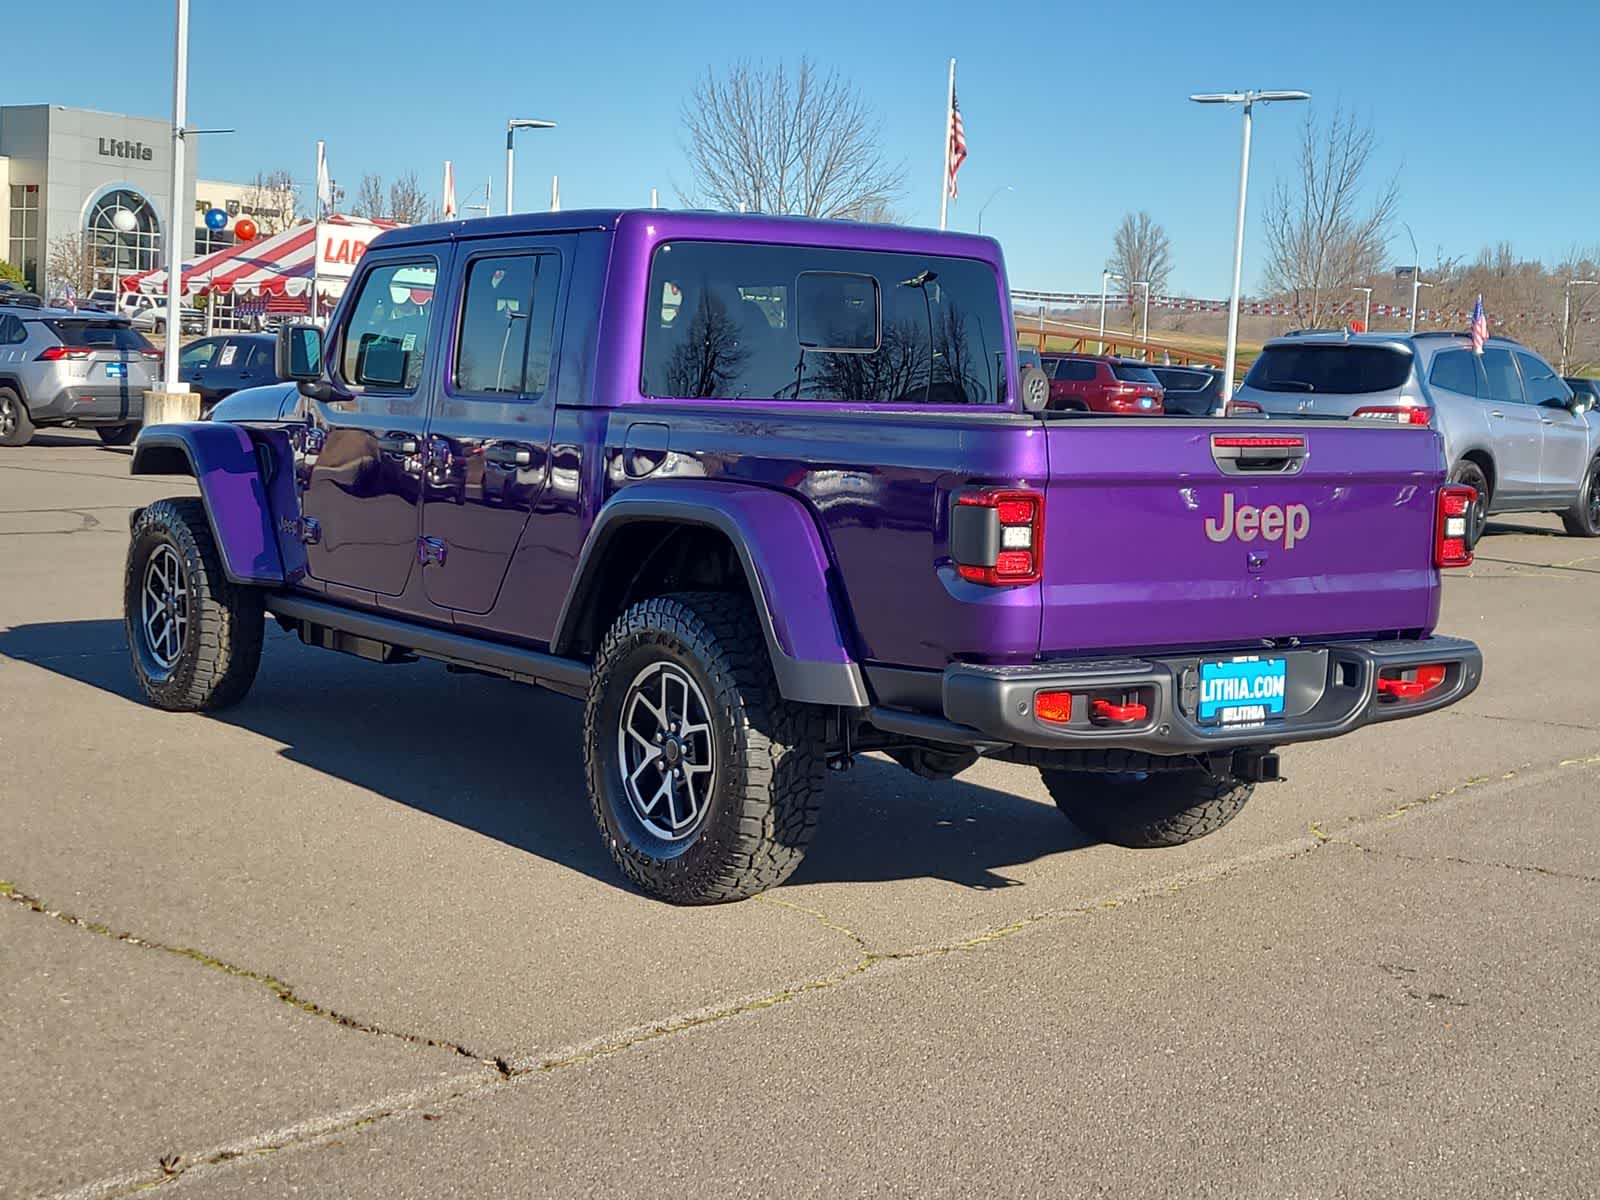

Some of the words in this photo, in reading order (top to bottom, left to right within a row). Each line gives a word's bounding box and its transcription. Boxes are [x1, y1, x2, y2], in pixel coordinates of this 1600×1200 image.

[99, 138, 152, 161] Lithia
[1205, 493, 1310, 549] Jeep
[1201, 675, 1285, 702] LITHIA.COM
